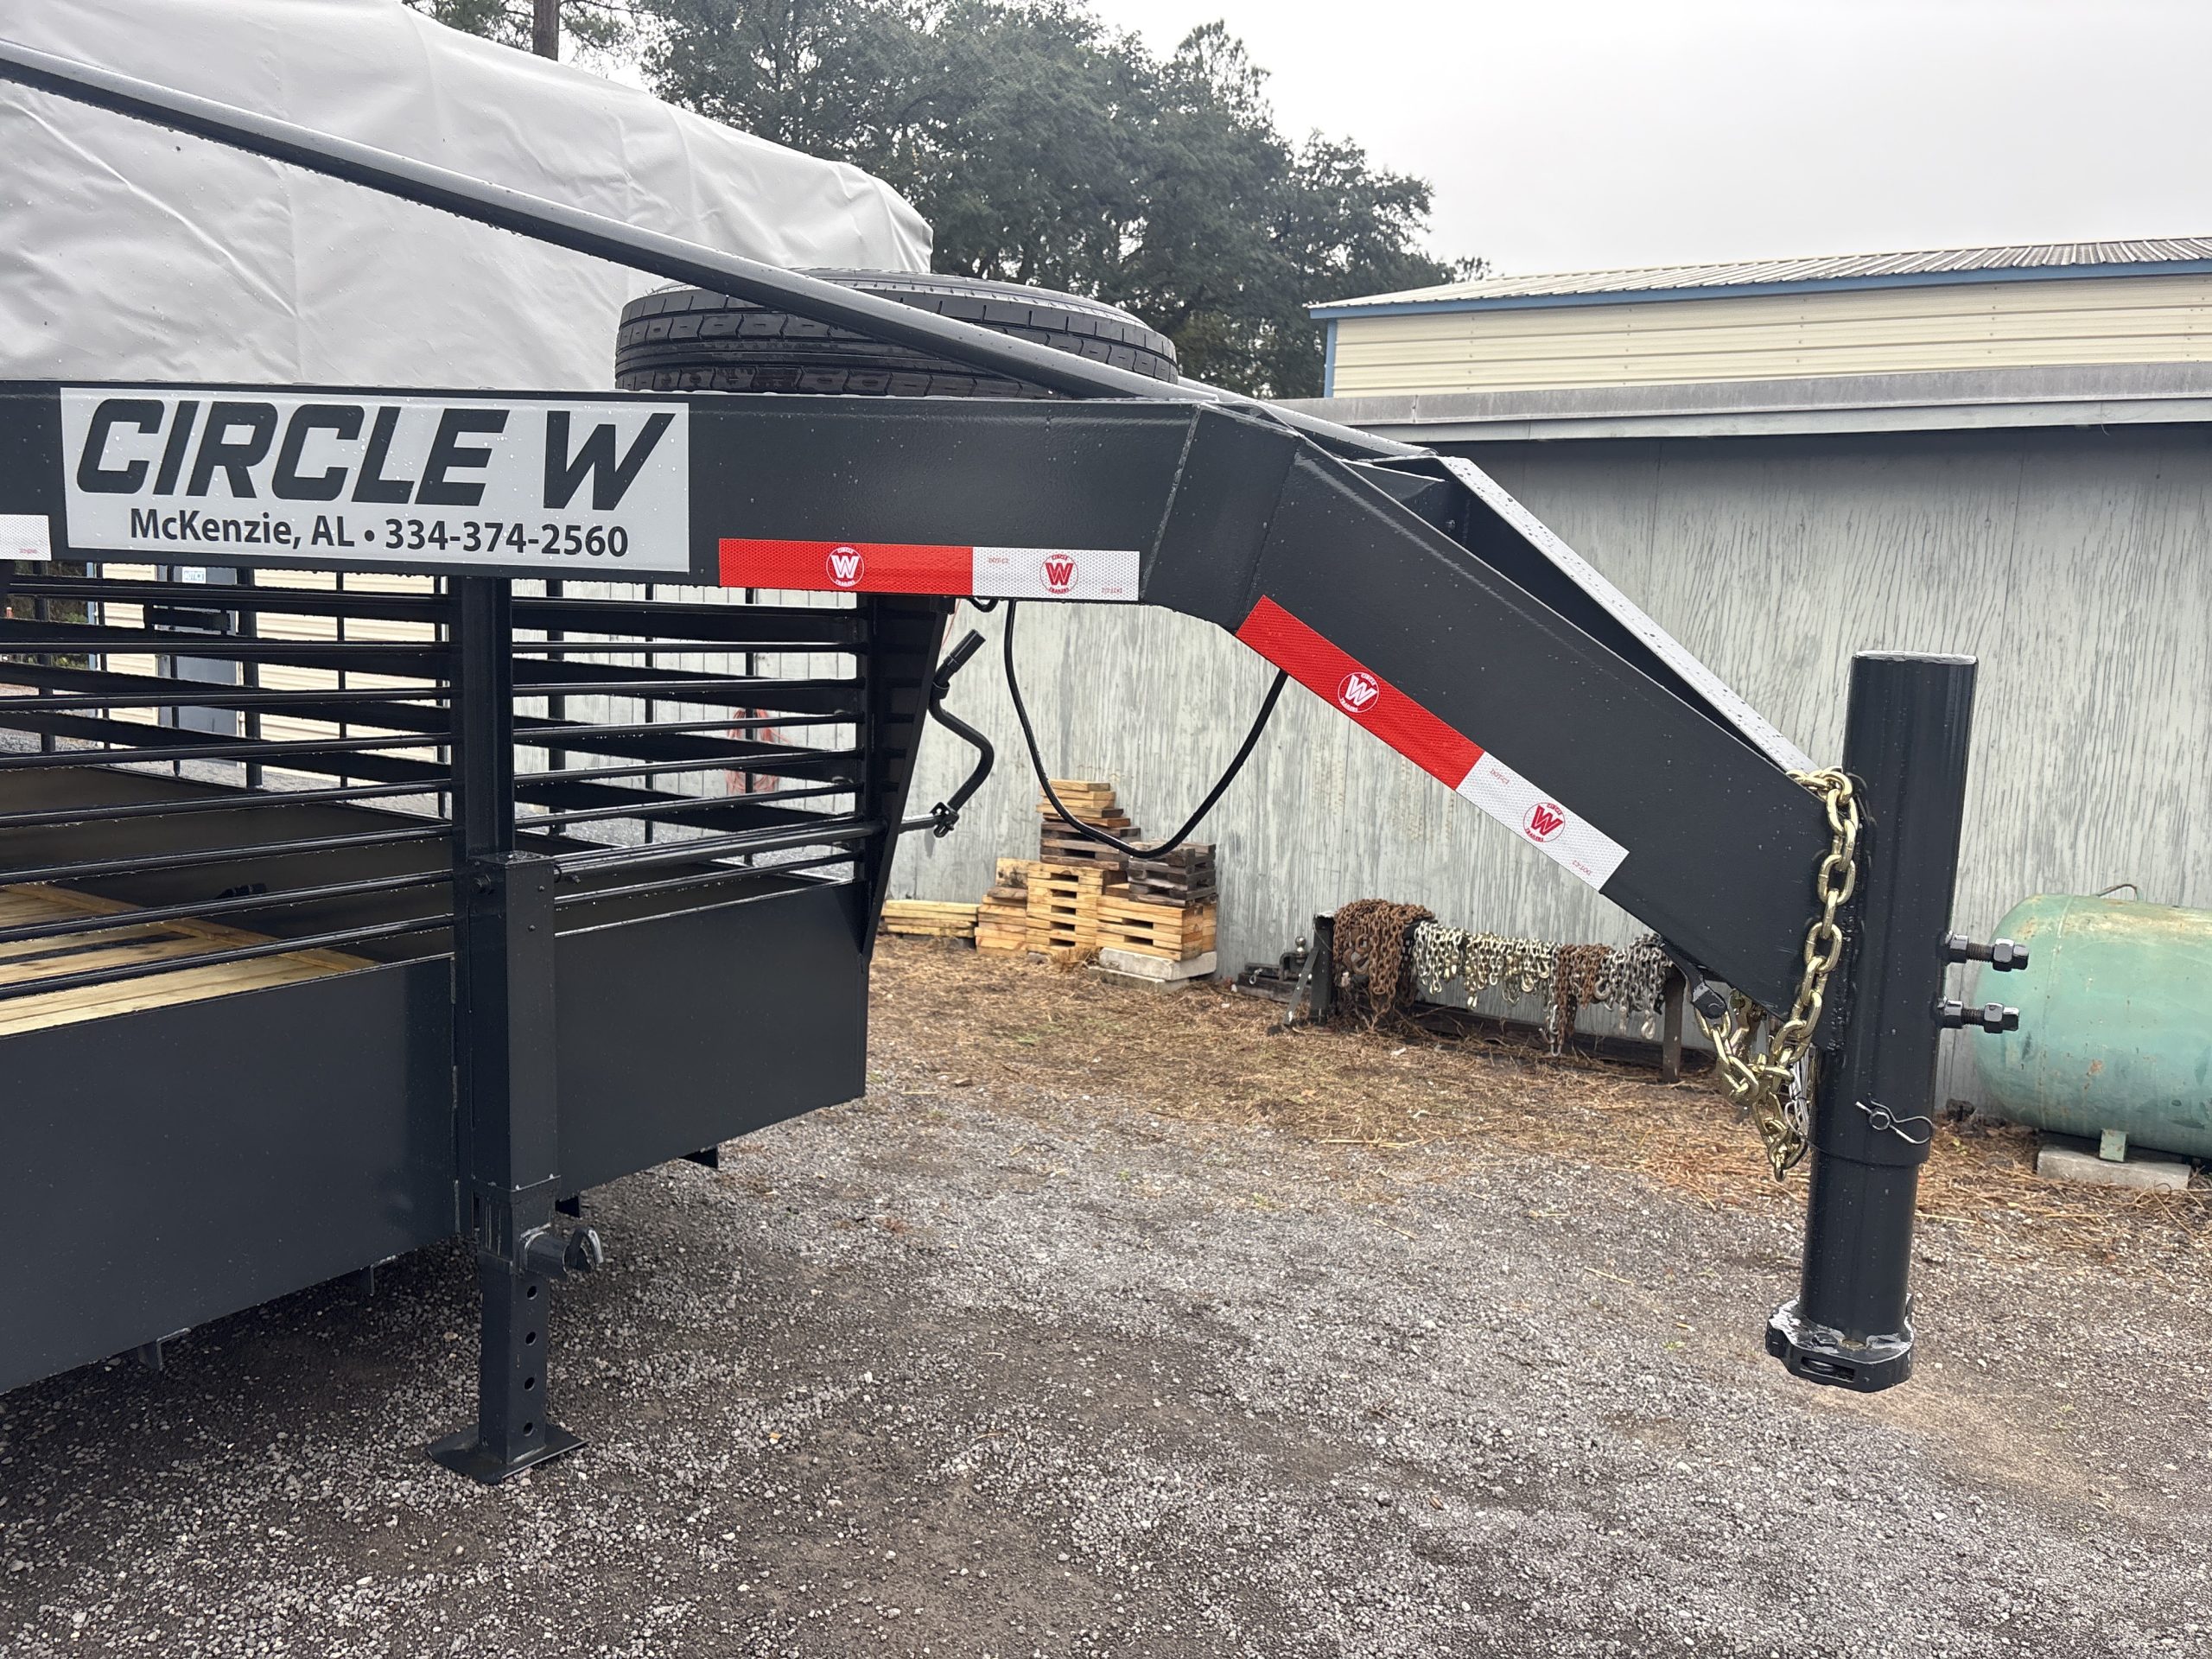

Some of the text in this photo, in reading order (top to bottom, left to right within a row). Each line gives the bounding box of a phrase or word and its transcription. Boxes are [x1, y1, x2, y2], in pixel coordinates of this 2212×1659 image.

[76, 398, 677, 512] CIRCLE W
[130, 507, 628, 557] McKenzie, AL 334-374-2560
[830, 555, 860, 579] W
[1045, 563, 1074, 586] W
[1344, 674, 1377, 707] W
[1530, 804, 1564, 836] W
